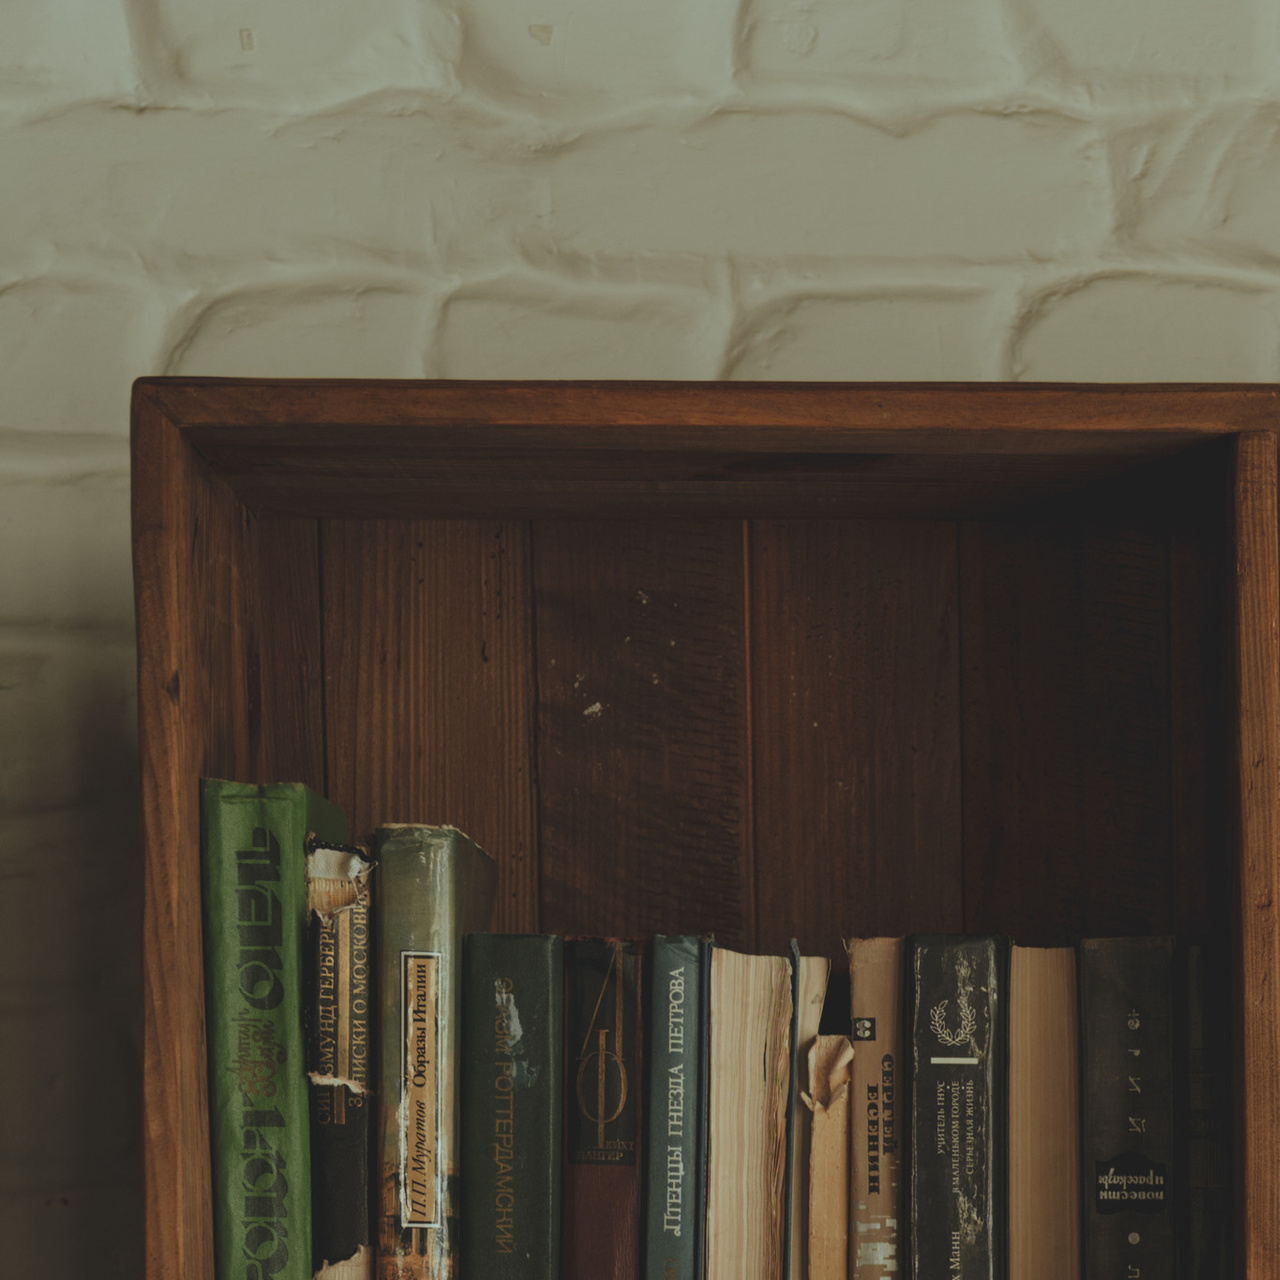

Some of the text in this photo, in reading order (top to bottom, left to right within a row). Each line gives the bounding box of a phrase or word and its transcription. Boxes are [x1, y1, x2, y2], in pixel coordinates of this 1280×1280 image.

[412, 963, 427, 1024] Италии
[668, 966, 685, 1055] ПЕТРОВА
[317, 1004, 337, 1125] СИГЗМУНД
[347, 1017, 367, 1108] ЗПИСКИ
[412, 1025, 430, 1089] Образы
[667, 1063, 685, 1138] ГНЕЗДА
[881, 1053, 899, 1156] СЕРГЕЙ
[936, 1080, 946, 1155] УЧИТЕЛЬ ГНУС
[951, 1080, 961, 1118] ГОРОДЕ
[965, 1079, 975, 1116] ЖИЗНЬ
[494, 1061, 517, 1254] РОТТЕРДАМСКИЙ
[866, 1082, 881, 1195] ЕСЕНИН
[951, 1119, 960, 1186] МАЛЕНЬКОМ
[1098, 1190, 1165, 1201] повести
[949, 1230, 961, 1270] Манн
